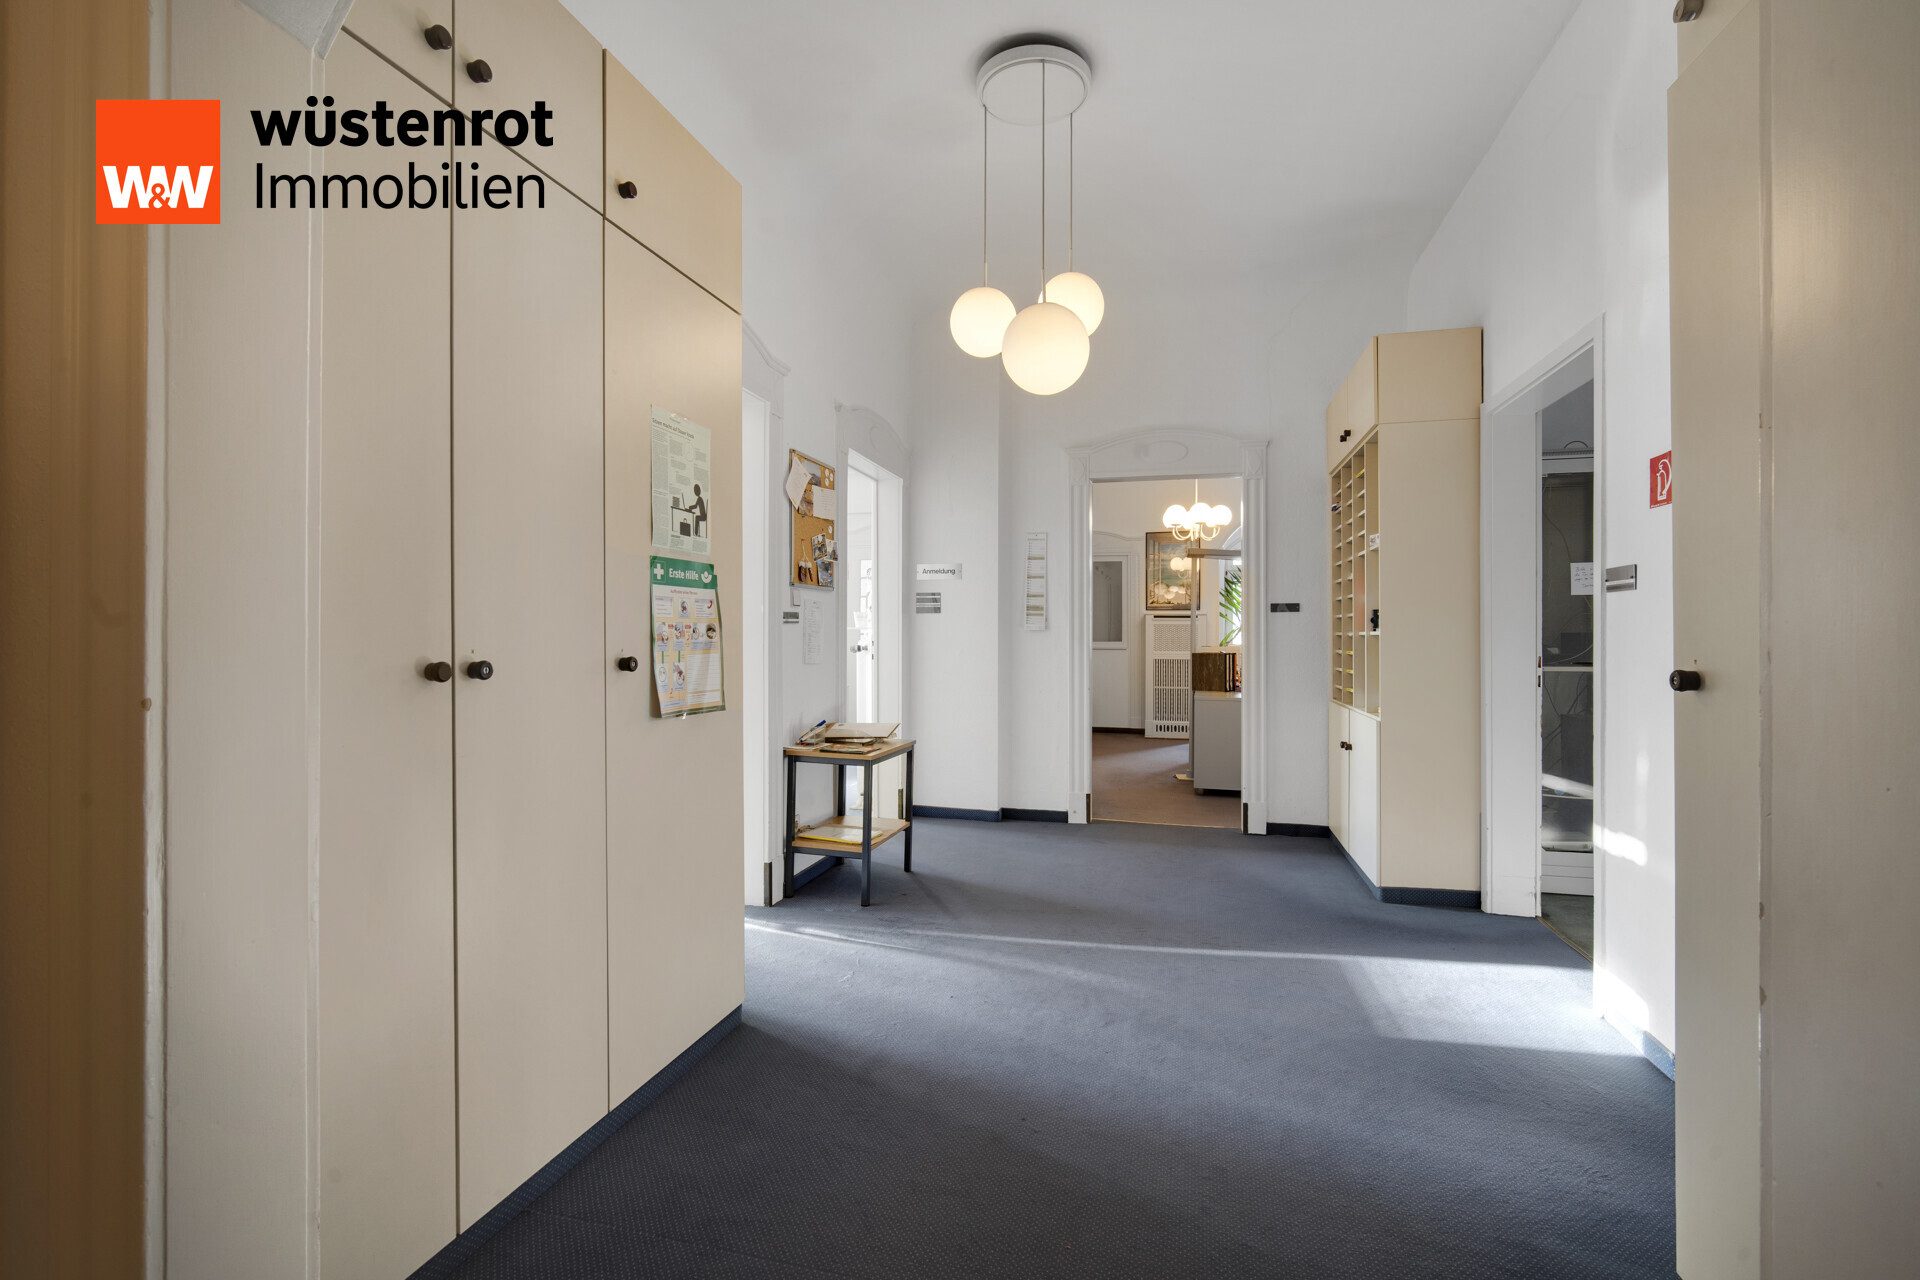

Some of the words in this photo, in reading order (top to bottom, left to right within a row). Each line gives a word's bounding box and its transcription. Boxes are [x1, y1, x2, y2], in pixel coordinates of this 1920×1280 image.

[669, 568, 685, 579] Erste
[685, 570, 699, 580] Hilfe
[922, 568, 956, 576] Anmeldung
